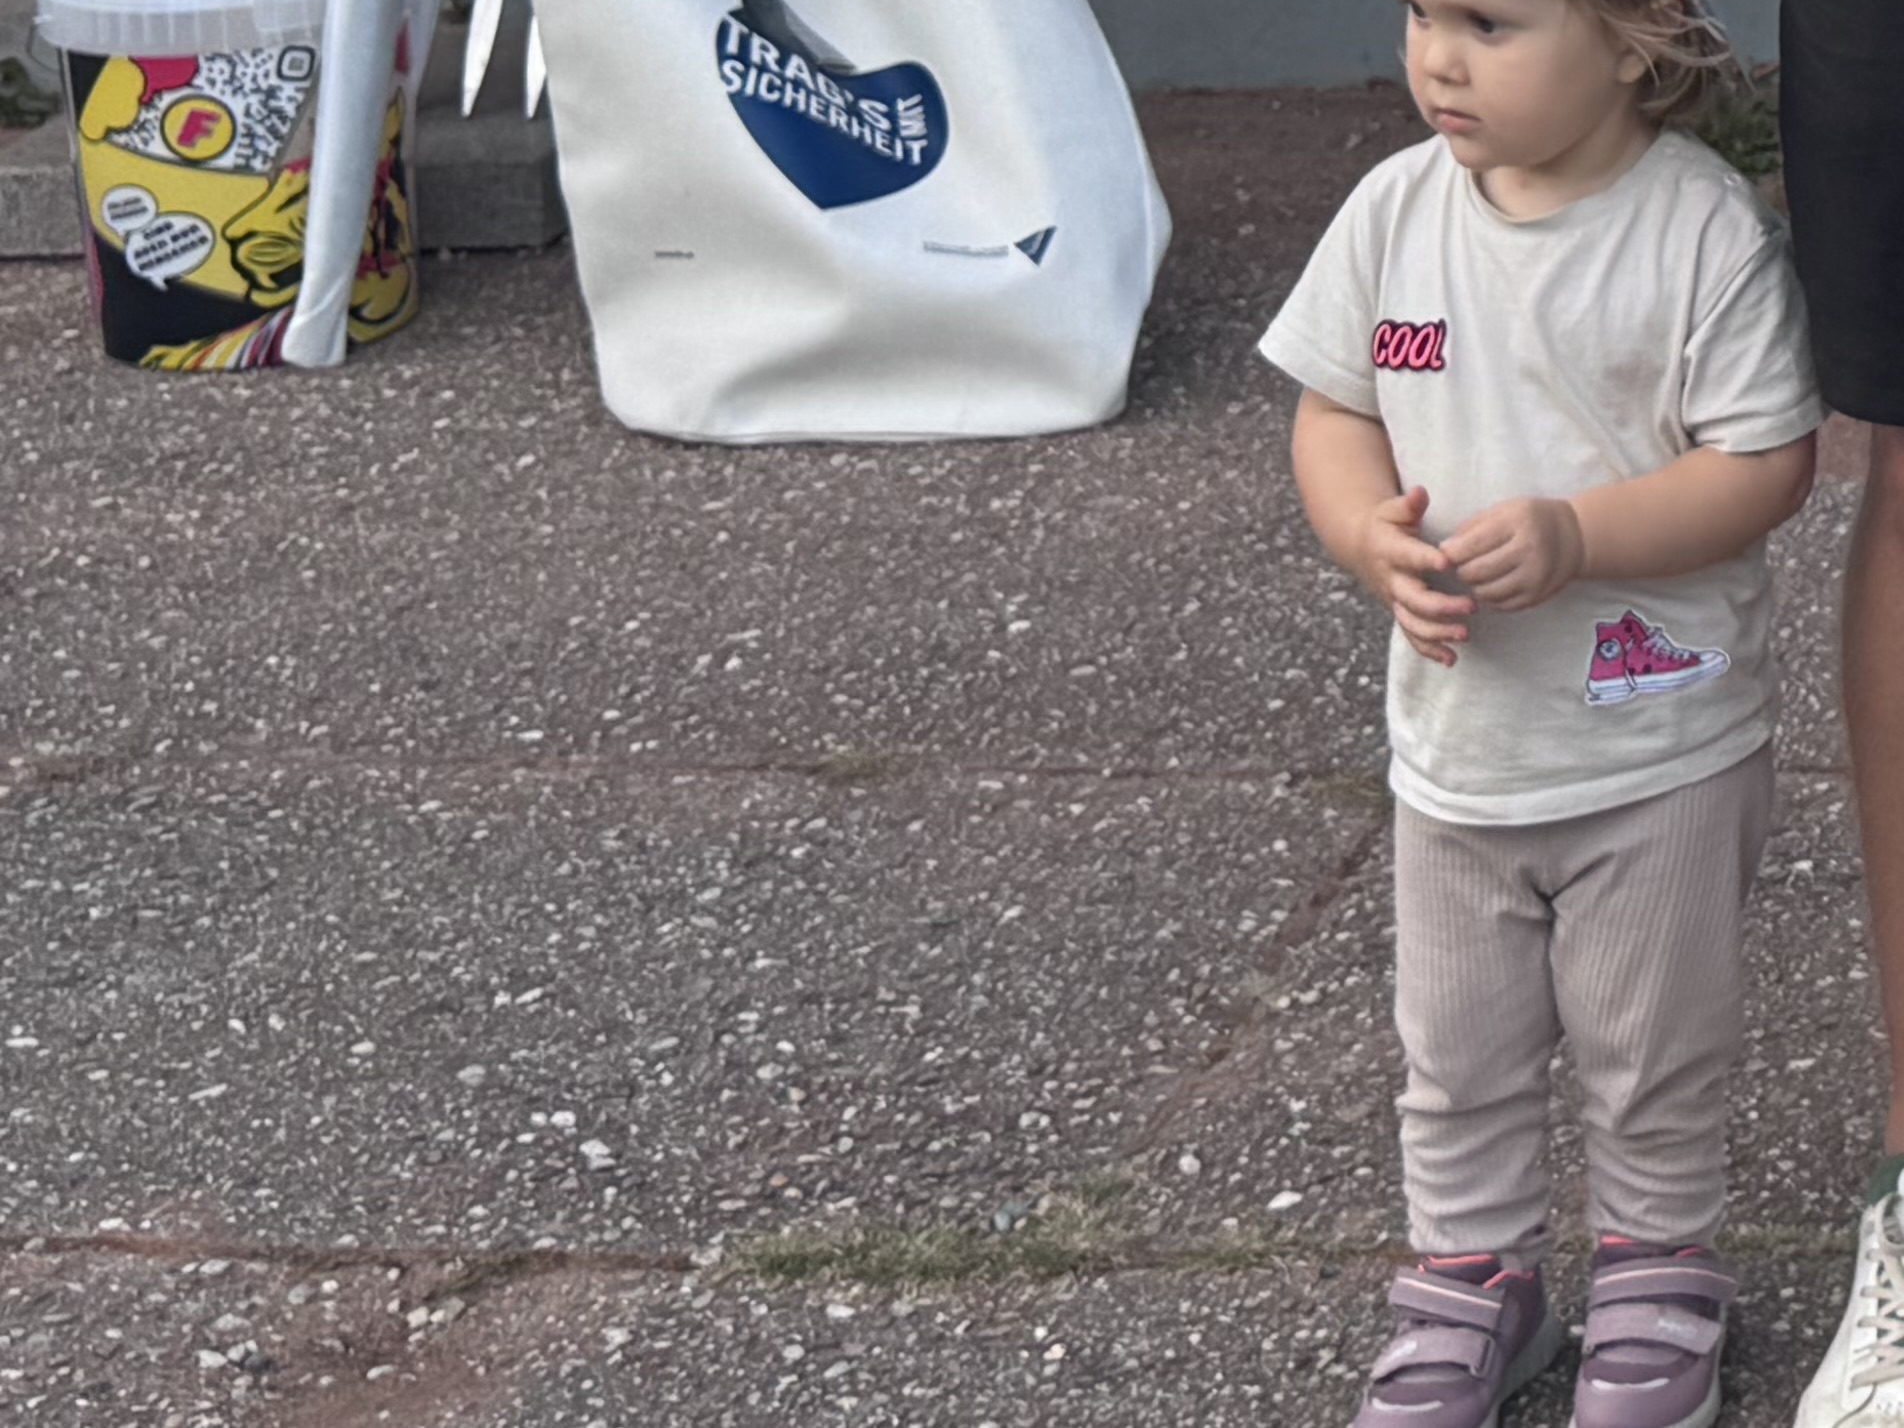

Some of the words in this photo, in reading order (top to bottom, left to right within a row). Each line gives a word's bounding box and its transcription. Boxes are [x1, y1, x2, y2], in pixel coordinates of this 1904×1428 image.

[176, 107, 222, 149] F
[720, 58, 929, 166] SICHERHEIT
[1372, 318, 1447, 371] COOL
